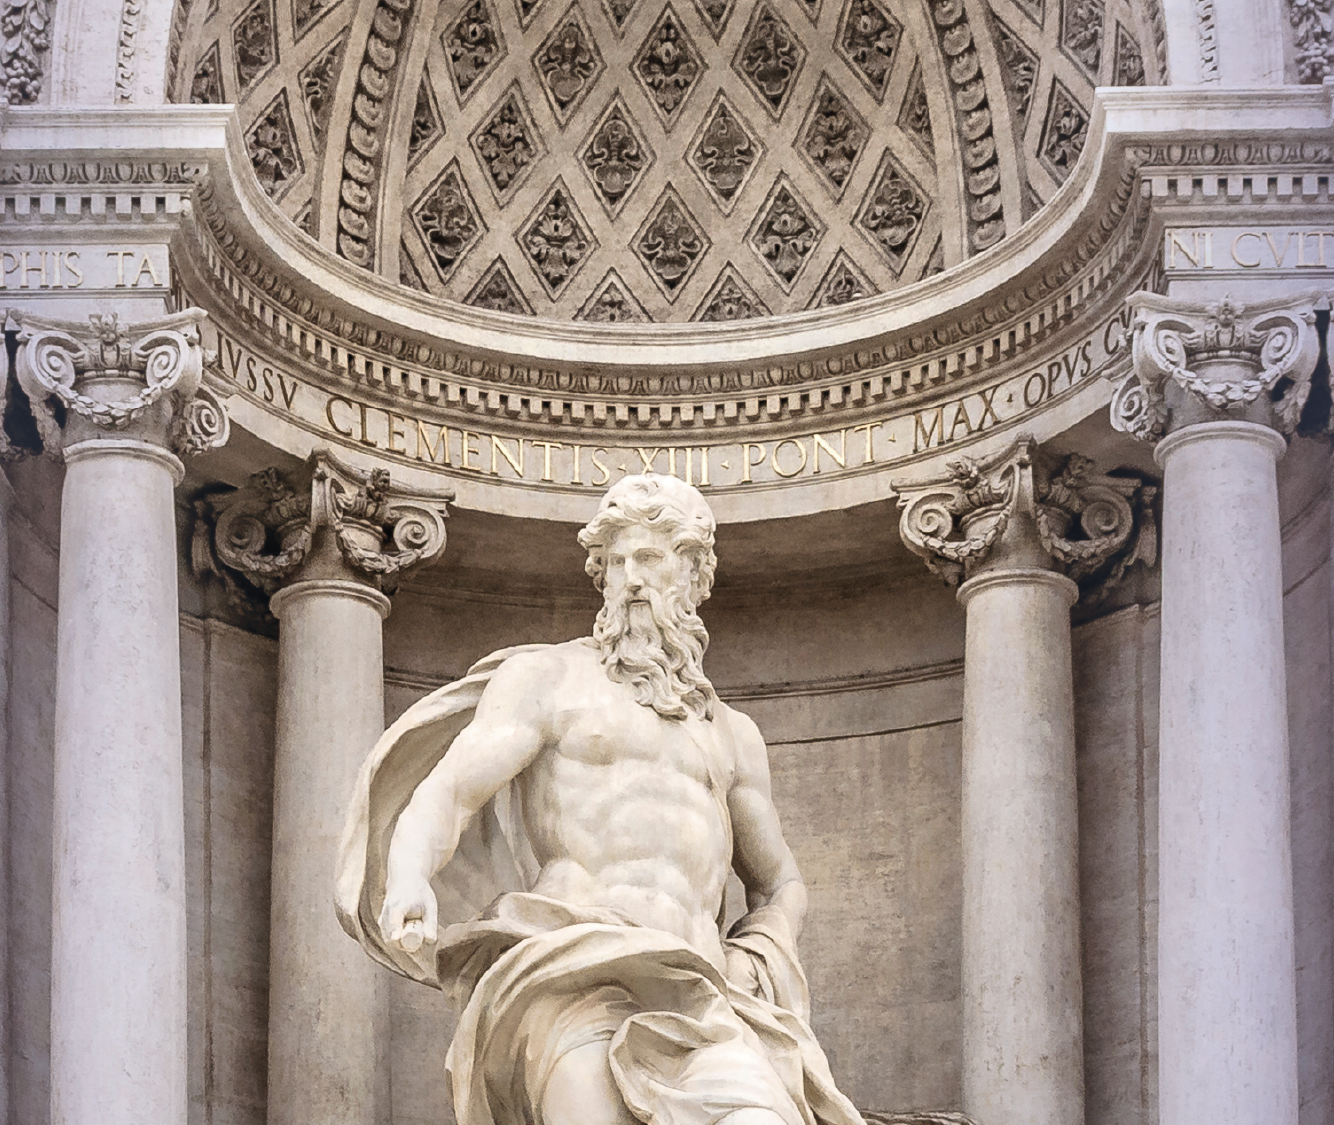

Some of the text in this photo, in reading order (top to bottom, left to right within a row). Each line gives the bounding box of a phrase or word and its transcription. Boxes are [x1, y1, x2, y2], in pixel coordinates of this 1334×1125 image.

[1167, 231, 1214, 269] NI
[216, 330, 299, 411] IVSSV
[326, 395, 610, 486] CLEMENTIS
[740, 421, 884, 483] PONT
[913, 385, 1002, 454] MAX
[1023, 340, 1092, 409] OPVS
